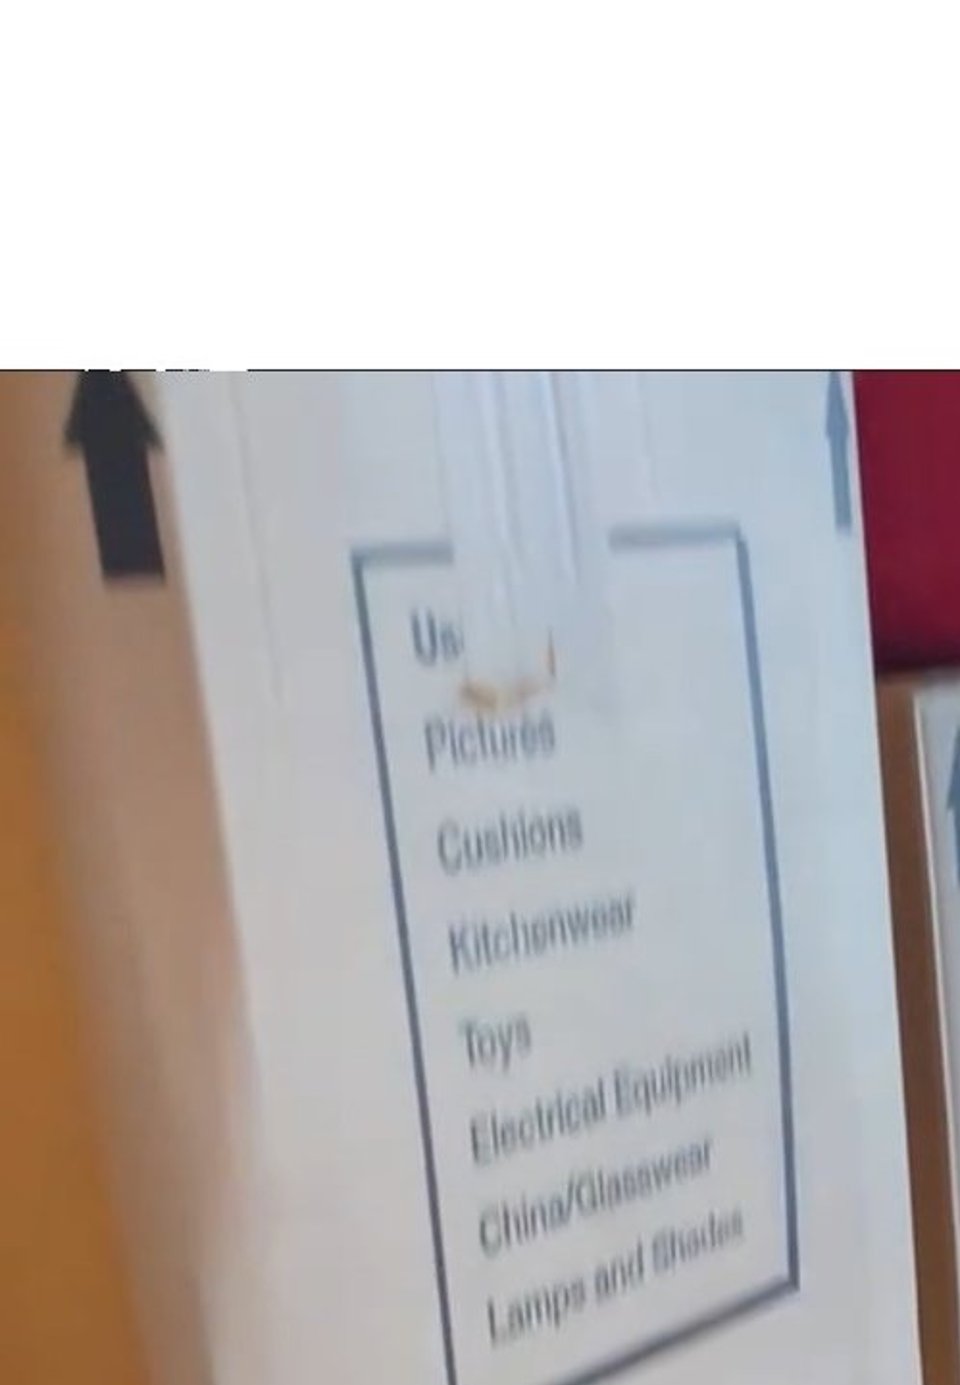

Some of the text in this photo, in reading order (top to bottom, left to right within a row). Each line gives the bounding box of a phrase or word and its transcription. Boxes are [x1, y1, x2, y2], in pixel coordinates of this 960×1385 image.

[409, 606, 465, 667] Us
[424, 711, 556, 773] Pictures
[437, 806, 584, 876] Cushions
[448, 891, 637, 977] Kitchenwear
[460, 1011, 532, 1072] Toys
[471, 1033, 753, 1166] Electrical Equipment
[479, 1135, 715, 1257] China/Glasswear
[487, 1207, 746, 1348] Lamps and Shades
